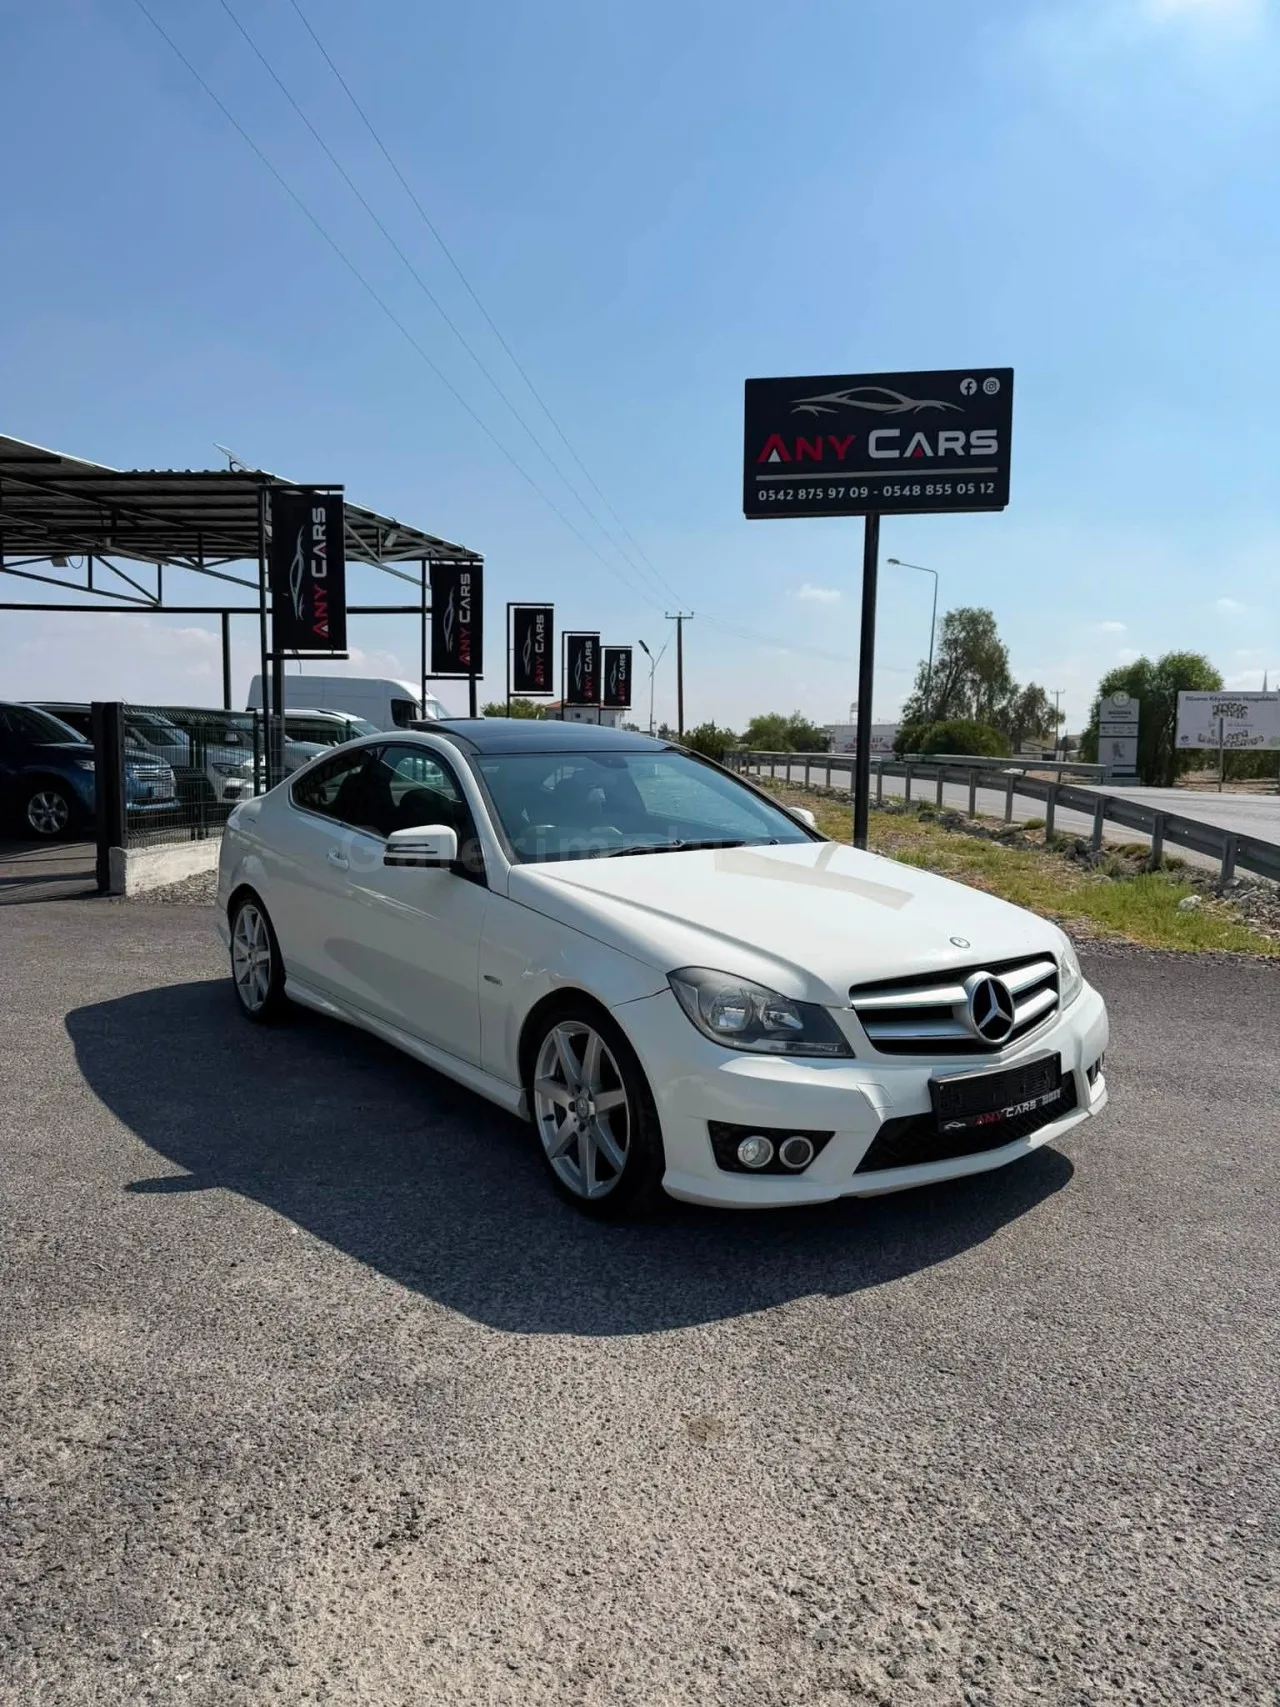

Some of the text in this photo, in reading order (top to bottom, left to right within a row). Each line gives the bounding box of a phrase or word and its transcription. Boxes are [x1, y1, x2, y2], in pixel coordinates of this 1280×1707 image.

[757, 428, 998, 463] ANY CARS
[758, 489, 794, 501] 0542
[798, 488, 823, 500] 875
[828, 487, 845, 499] 97
[849, 486, 868, 498] 09
[883, 485, 921, 497] 0548
[925, 483, 952, 496] 855
[956, 482, 975, 495] 05
[980, 482, 994, 494] 12
[311, 507, 329, 638] ANY CARS
[459, 573, 471, 666] ANY CARS
[535, 614, 544, 653] CARS
[584, 640, 592, 672] CARS
[1006, 1099, 1037, 1118] CARS
